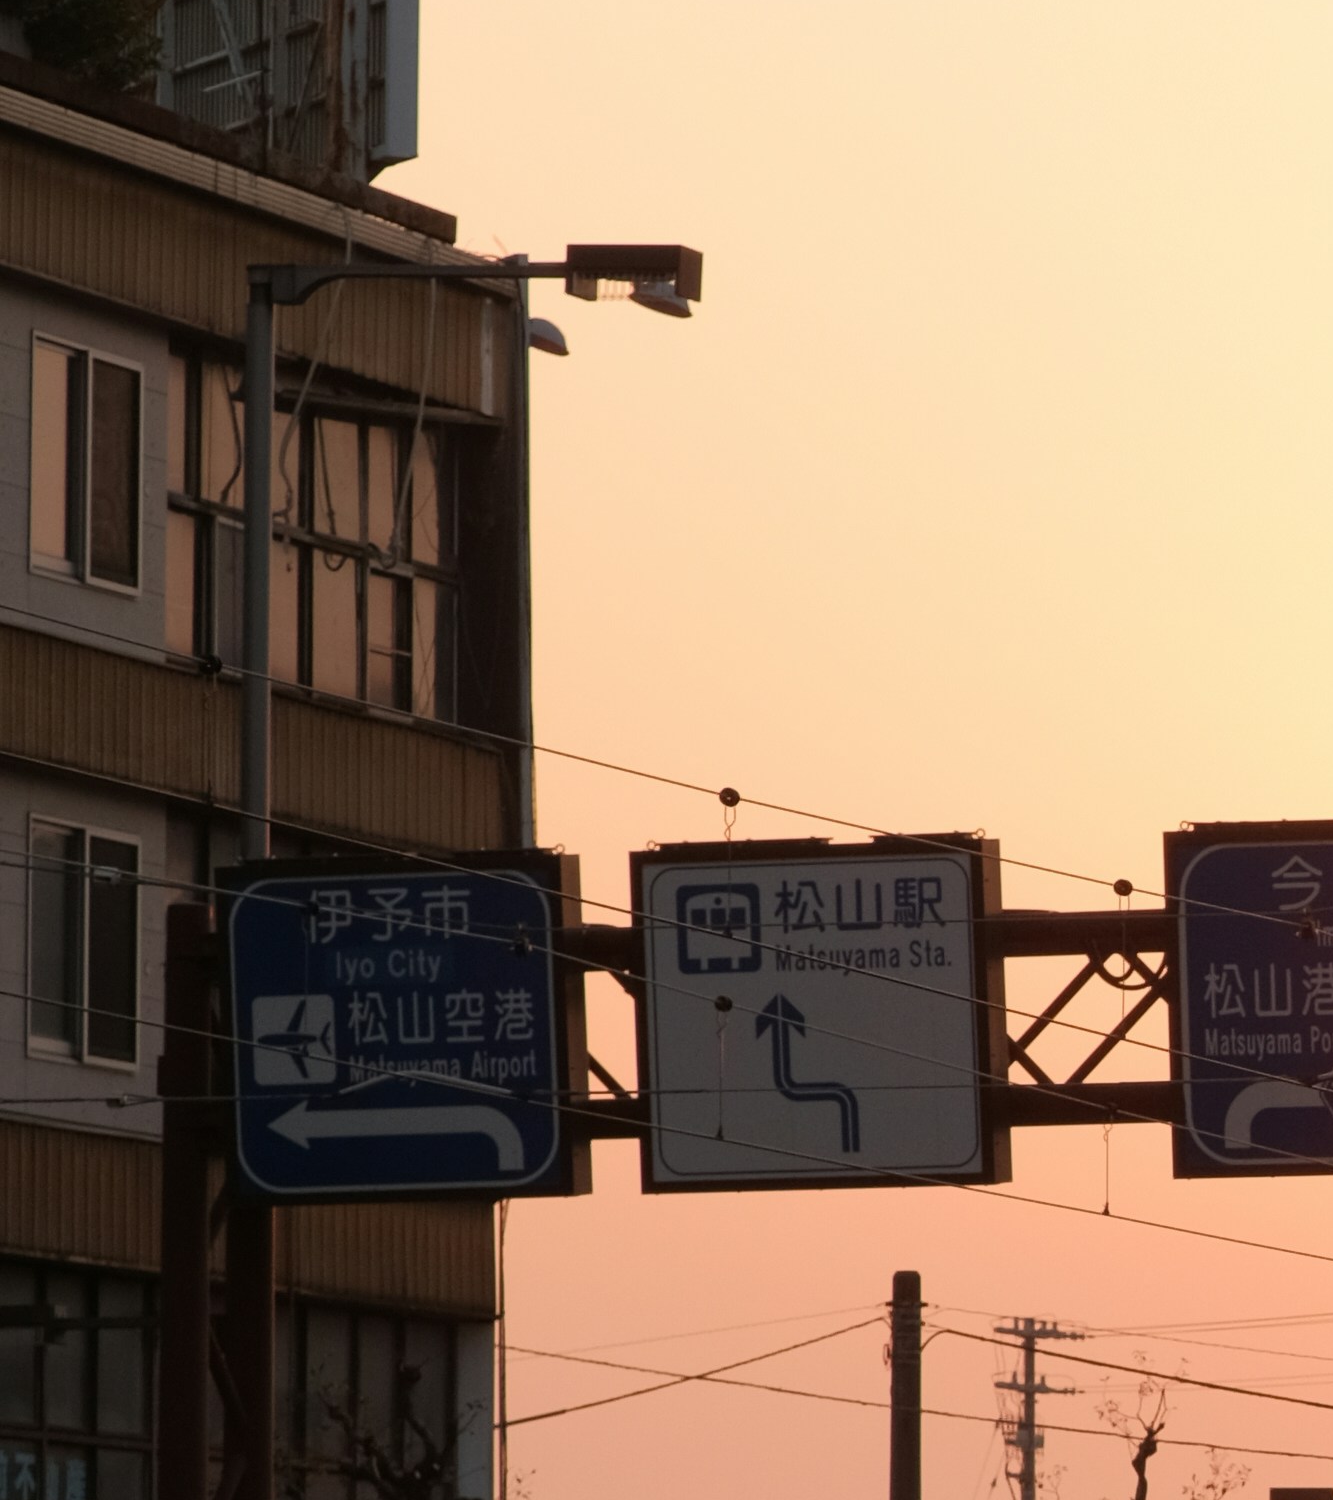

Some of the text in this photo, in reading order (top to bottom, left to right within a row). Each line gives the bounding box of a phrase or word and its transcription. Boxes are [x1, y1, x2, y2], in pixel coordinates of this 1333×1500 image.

[306, 883, 471, 945] 伊予市
[774, 875, 946, 934] 松山駅
[334, 948, 443, 985] Iyo City
[776, 941, 953, 977] Matsuyama Sta.
[347, 987, 535, 1046] 松山空港
[1204, 1025, 1303, 1062] Matsuyama
[348, 1051, 538, 1088] Matsuyama Airport
